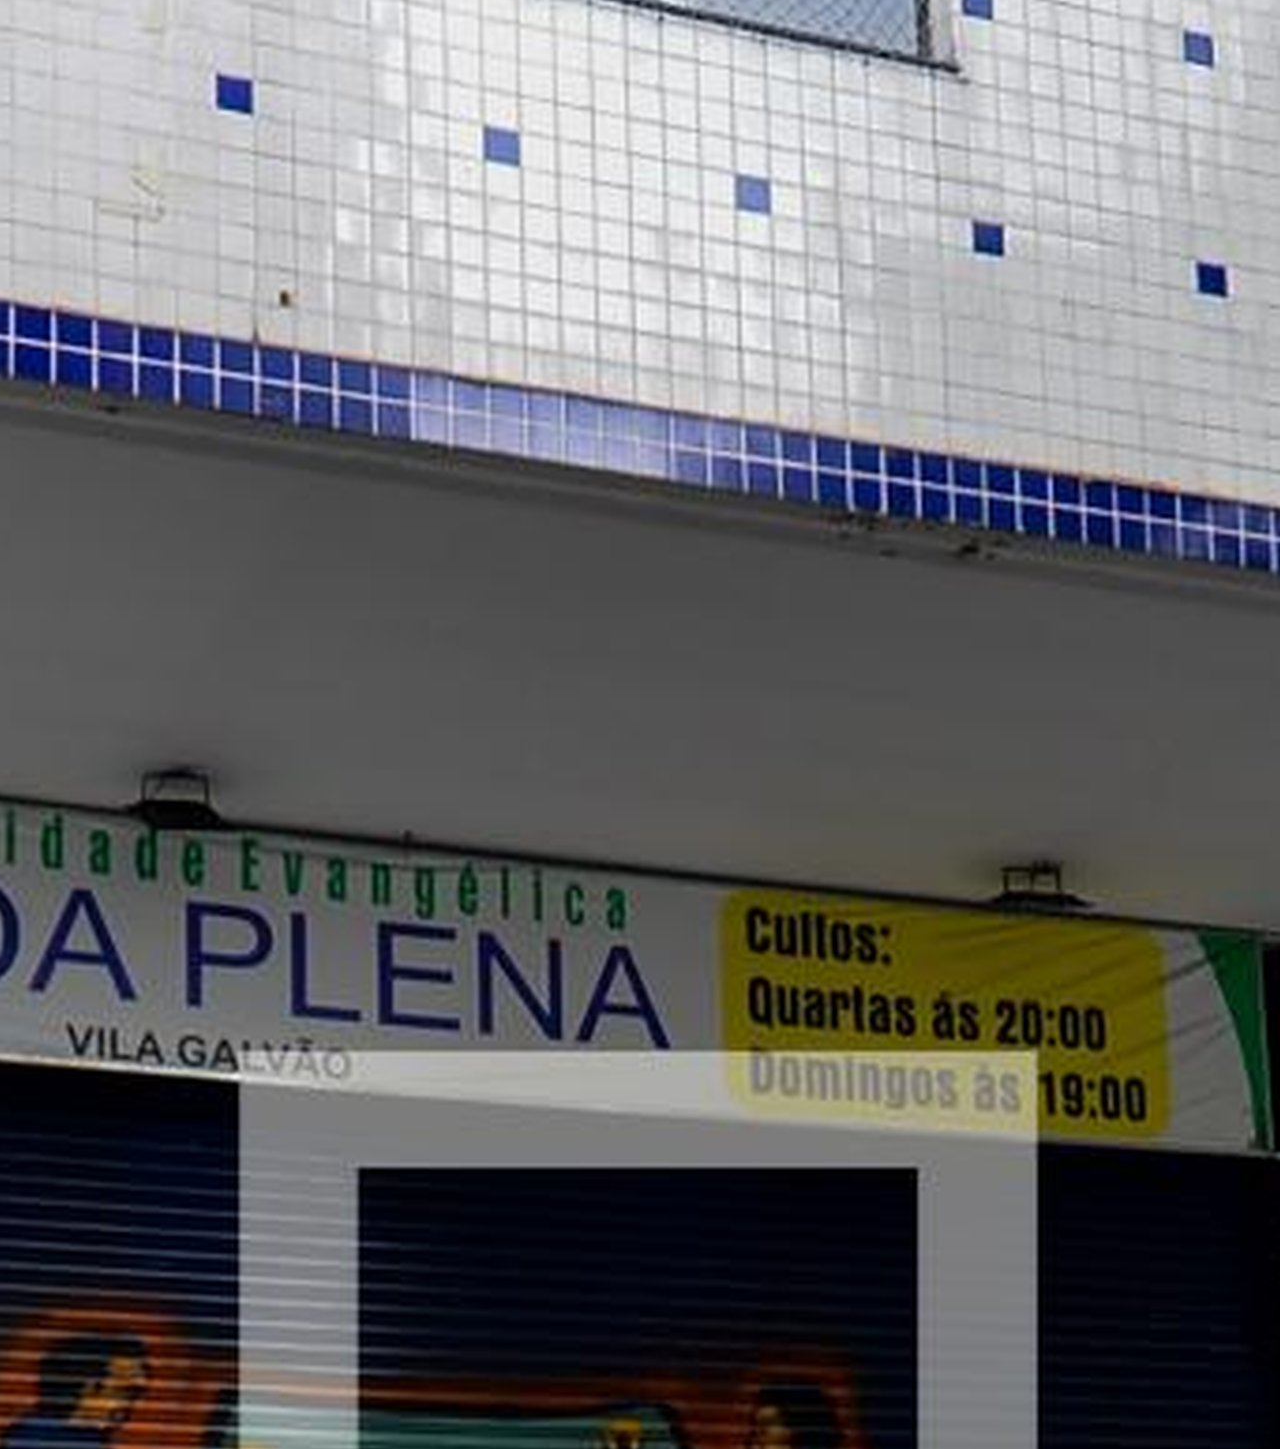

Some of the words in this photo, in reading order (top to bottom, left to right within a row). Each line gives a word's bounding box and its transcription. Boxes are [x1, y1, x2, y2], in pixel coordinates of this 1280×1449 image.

[241, 838, 628, 930] Evangélica
[745, 906, 894, 966] Cultos:
[184, 900, 671, 1049] PLENA
[747, 976, 918, 1039] Quartas
[994, 999, 1108, 1050] 20:00
[66, 1024, 162, 1065] VILA
[177, 1036, 350, 1080] GALVÃO
[748, 1047, 958, 1112] Domingos
[1040, 1071, 1147, 1122] 19:00
